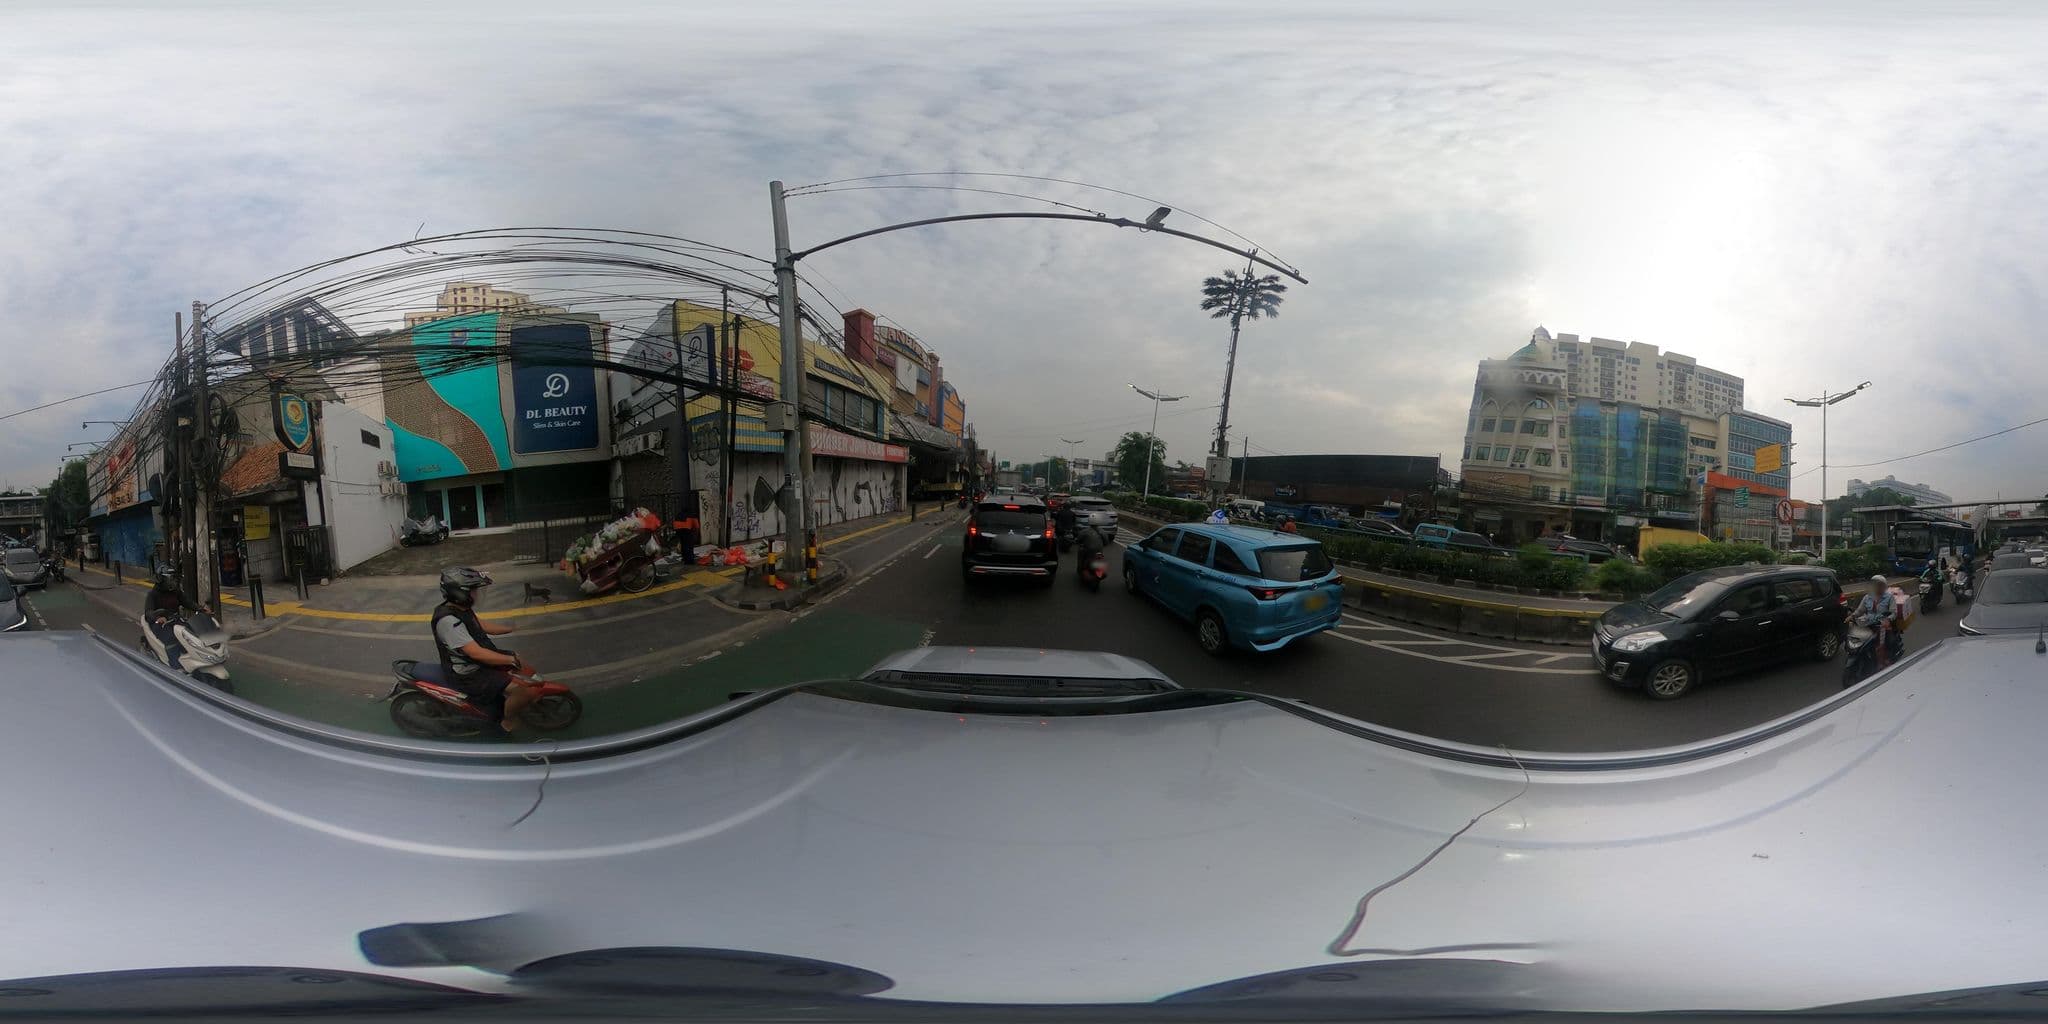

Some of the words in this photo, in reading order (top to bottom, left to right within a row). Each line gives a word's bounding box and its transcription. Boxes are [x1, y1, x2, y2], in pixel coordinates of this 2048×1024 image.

[526, 410, 541, 419] DL
[544, 406, 587, 418] BEAUTY
[567, 419, 581, 427] Care
